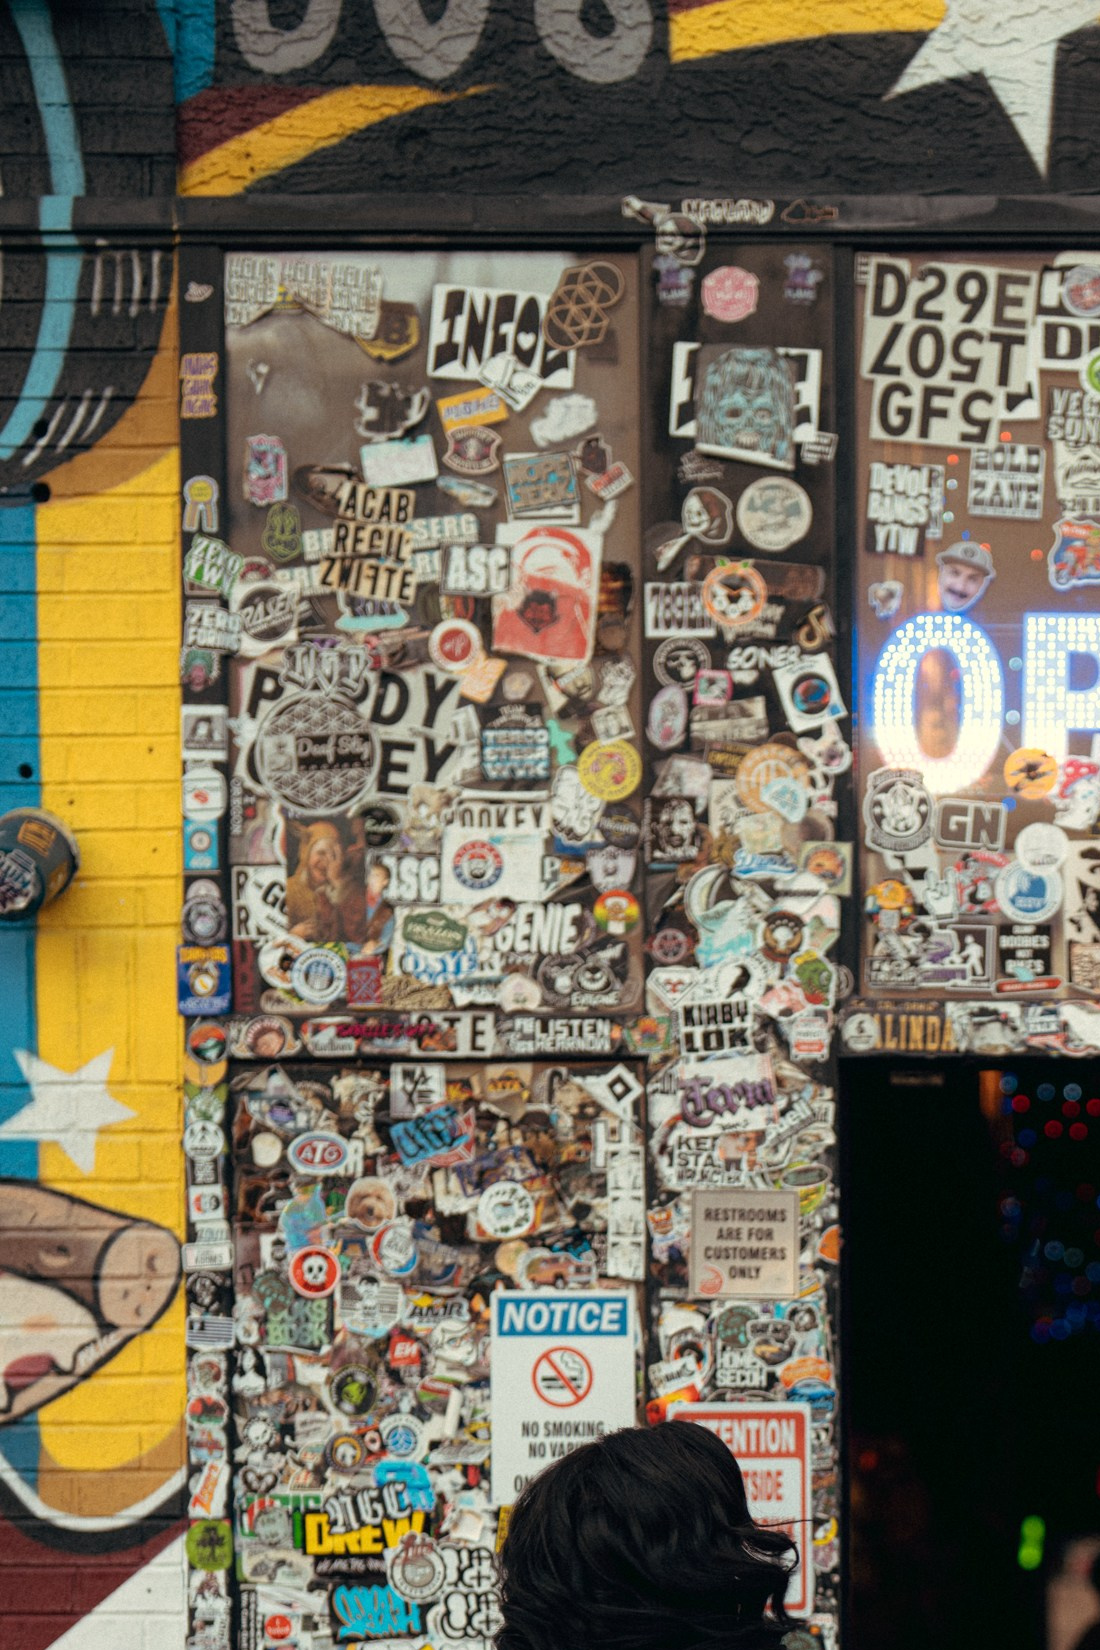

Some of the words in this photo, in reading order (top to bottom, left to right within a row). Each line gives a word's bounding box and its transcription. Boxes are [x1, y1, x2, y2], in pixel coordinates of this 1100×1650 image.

[870, 262, 1032, 329] D29E
[342, 485, 411, 524] ACAB
[683, 999, 749, 1027] KIRBY
[535, 1018, 612, 1038] LISTEN
[703, 1207, 788, 1223] RESTROOMS
[715, 1226, 742, 1242] ARE
[747, 1226, 775, 1241] FOR
[703, 1246, 788, 1261] CUSTOMERS
[728, 1265, 762, 1280] ONLY
[501, 1300, 625, 1333] NOTICE
[521, 1420, 539, 1438] NO
[543, 1420, 605, 1438] SMOKING
[717, 1417, 797, 1454] ENTION
[528, 1441, 546, 1459] NO
[743, 1470, 783, 1502] TSIDE
[304, 1510, 426, 1556] DREW
